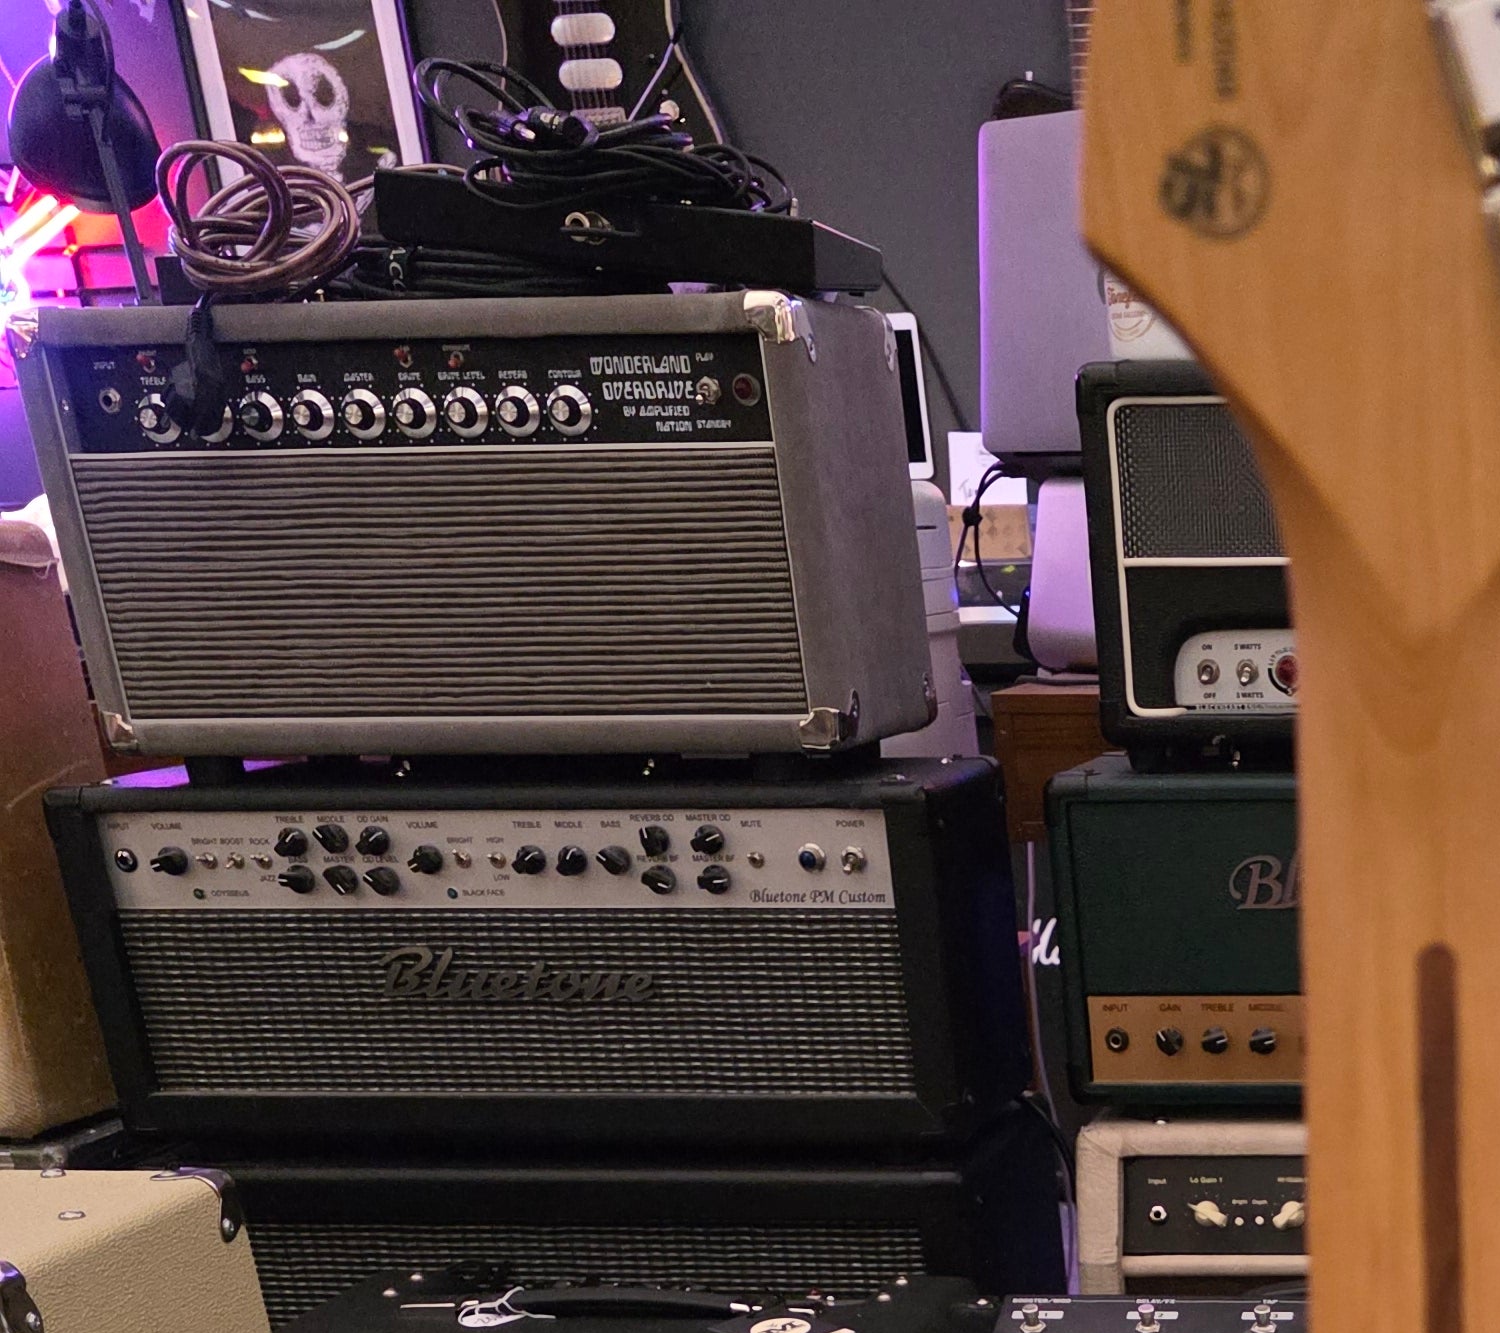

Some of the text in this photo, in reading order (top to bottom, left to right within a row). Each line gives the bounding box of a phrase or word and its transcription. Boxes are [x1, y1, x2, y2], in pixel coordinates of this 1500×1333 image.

[589, 355, 692, 376] WONDERLAND
[602, 381, 695, 401] OVERDRIVE
[622, 405, 691, 417] BY AMPLIFIED
[655, 420, 693, 432] NATION
[1201, 643, 1212, 651] ON
[1241, 691, 1264, 699] WATTS
[275, 815, 304, 823] TREBLE
[316, 815, 345, 823] MIDDLE
[369, 815, 389, 823] GAIN
[629, 814, 662, 822] REVERB
[685, 813, 718, 822] MASTER
[150, 822, 183, 831] VOLUME
[406, 820, 439, 829] VOLUME
[512, 820, 542, 829] TREBLE
[554, 820, 583, 829] MIDDLE
[740, 820, 762, 828] MUTE
[835, 819, 865, 828] POWER
[323, 855, 355, 864] MASTER
[259, 874, 277, 882] JAZZ
[493, 874, 511, 882] LOW
[749, 887, 886, 903] Bluetone PM Custom
[378, 945, 654, 1001] Bluetone
[1102, 1003, 1128, 1012] INPUT
[1159, 1003, 1182, 1012] GAIN
[1201, 1003, 1234, 1012] TREBLE
